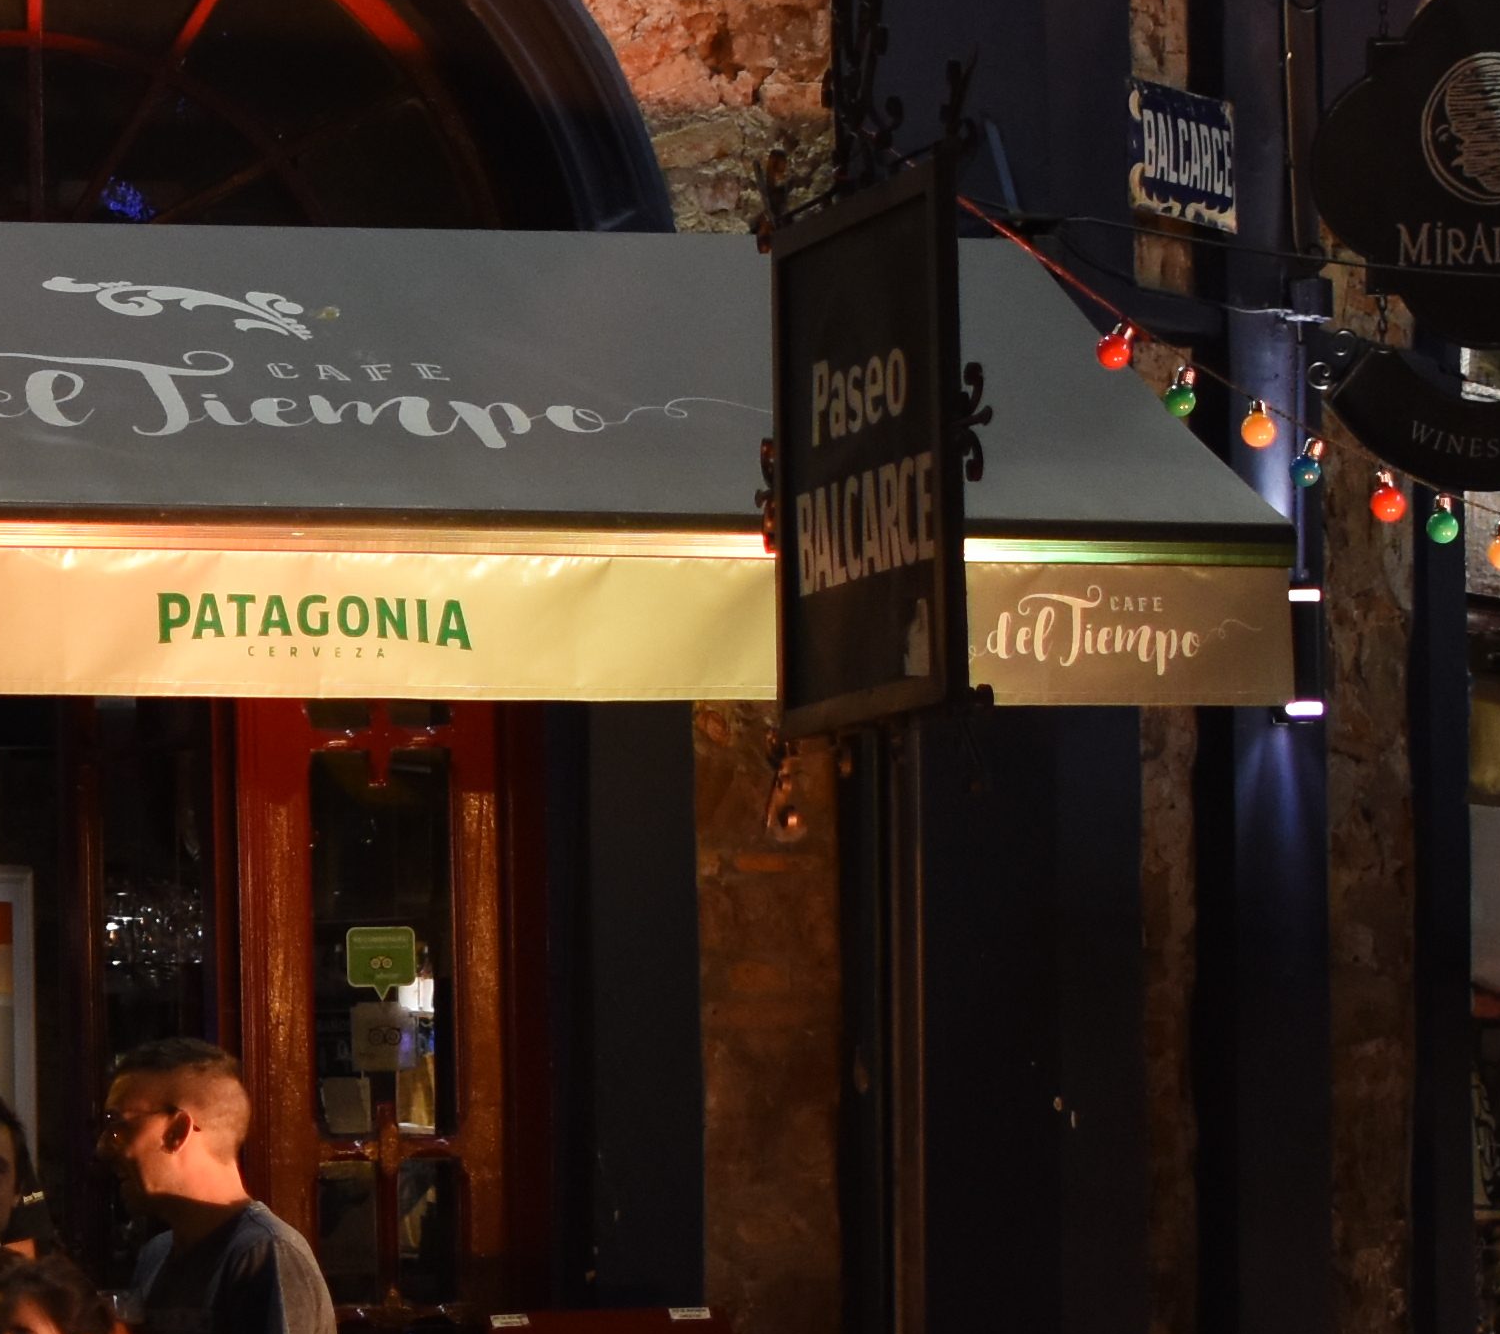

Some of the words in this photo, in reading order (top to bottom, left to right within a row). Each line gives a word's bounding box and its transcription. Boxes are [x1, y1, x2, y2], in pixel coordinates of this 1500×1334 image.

[1142, 109, 1234, 198] BALCARCE
[267, 362, 452, 382] CAFE
[810, 348, 908, 449] Paseo
[796, 451, 936, 598] BALCARCE
[157, 591, 473, 651] PATAGONIA
[986, 604, 1056, 662] del
[1017, 584, 1203, 676] Tiempo
[1110, 595, 1164, 613] CAFE
[247, 644, 386, 660] CERVEZA
